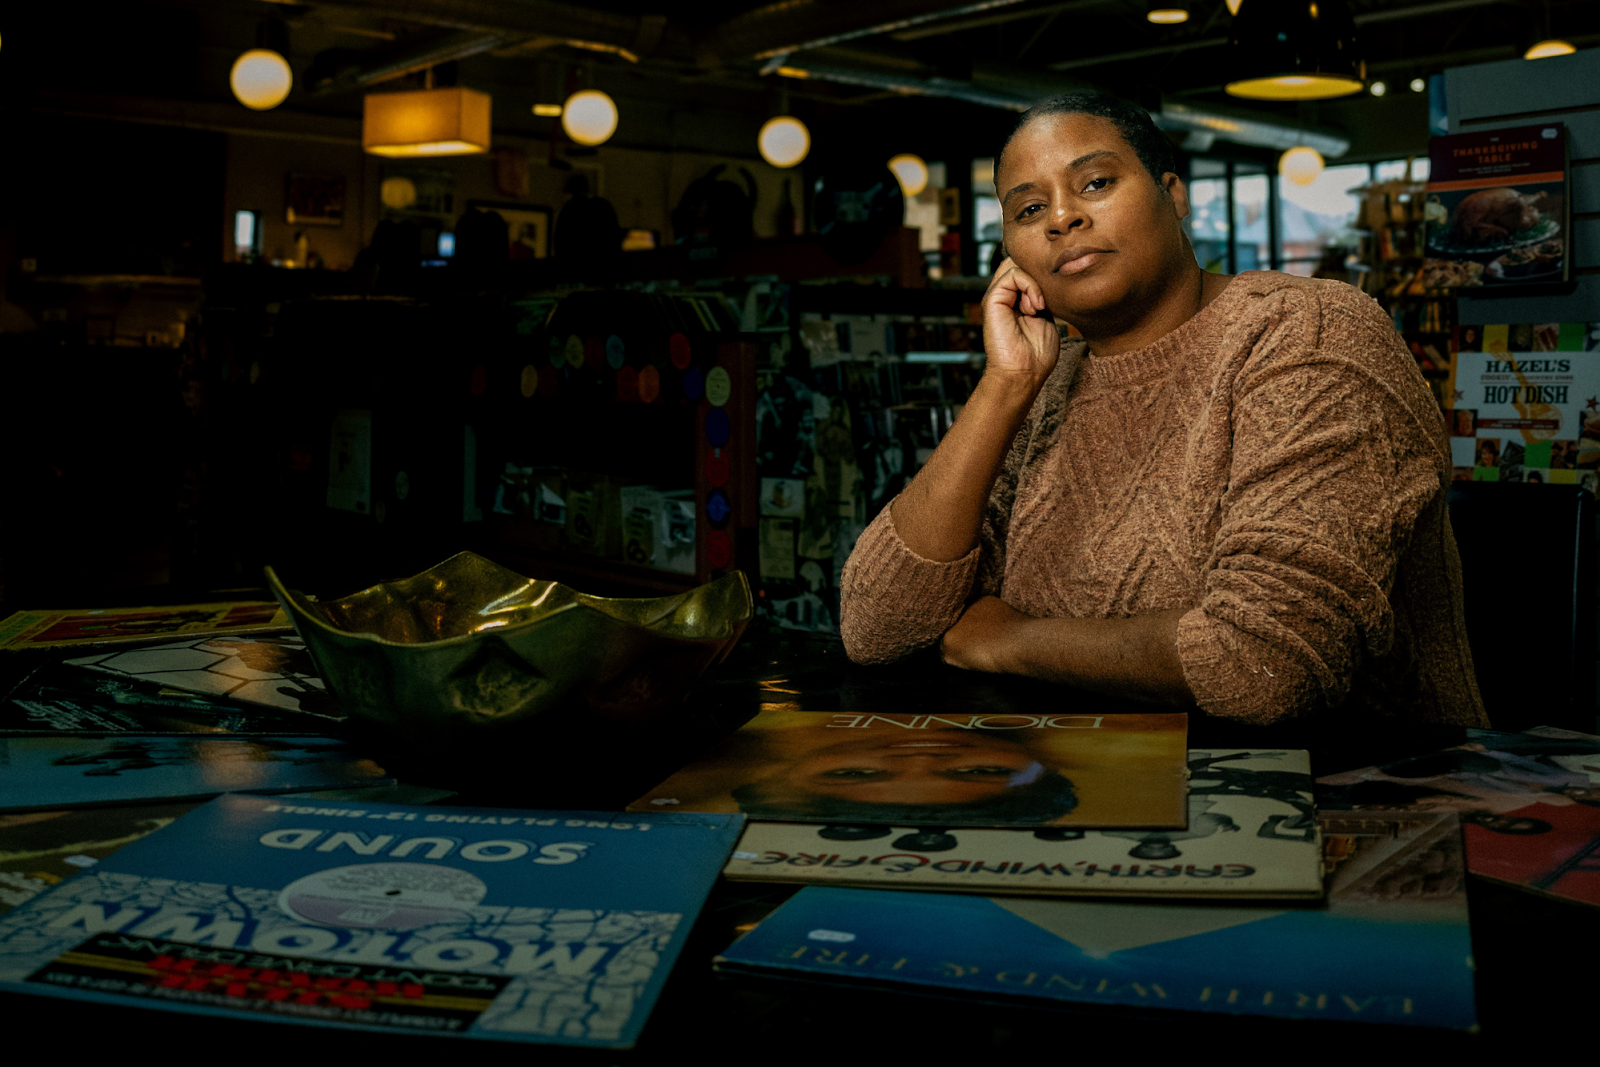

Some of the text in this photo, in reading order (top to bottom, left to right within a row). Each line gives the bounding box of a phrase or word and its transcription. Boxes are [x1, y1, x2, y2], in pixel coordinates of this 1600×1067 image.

[1453, 141, 1538, 157] THANKSGIVING
[1478, 153, 1511, 164] TABLE
[1486, 360, 1570, 373] HAZEL'S
[1484, 385, 1568, 404] HOT DISH
[826, 713, 1104, 729] DIONNE
[259, 828, 592, 866] SOUND
[751, 851, 868, 868] FIRE
[47, 903, 609, 975] MOTOWN
[775, 946, 908, 972] FIRE
[995, 970, 1168, 1000] WIND
[1198, 986, 1414, 1016] EARTH
